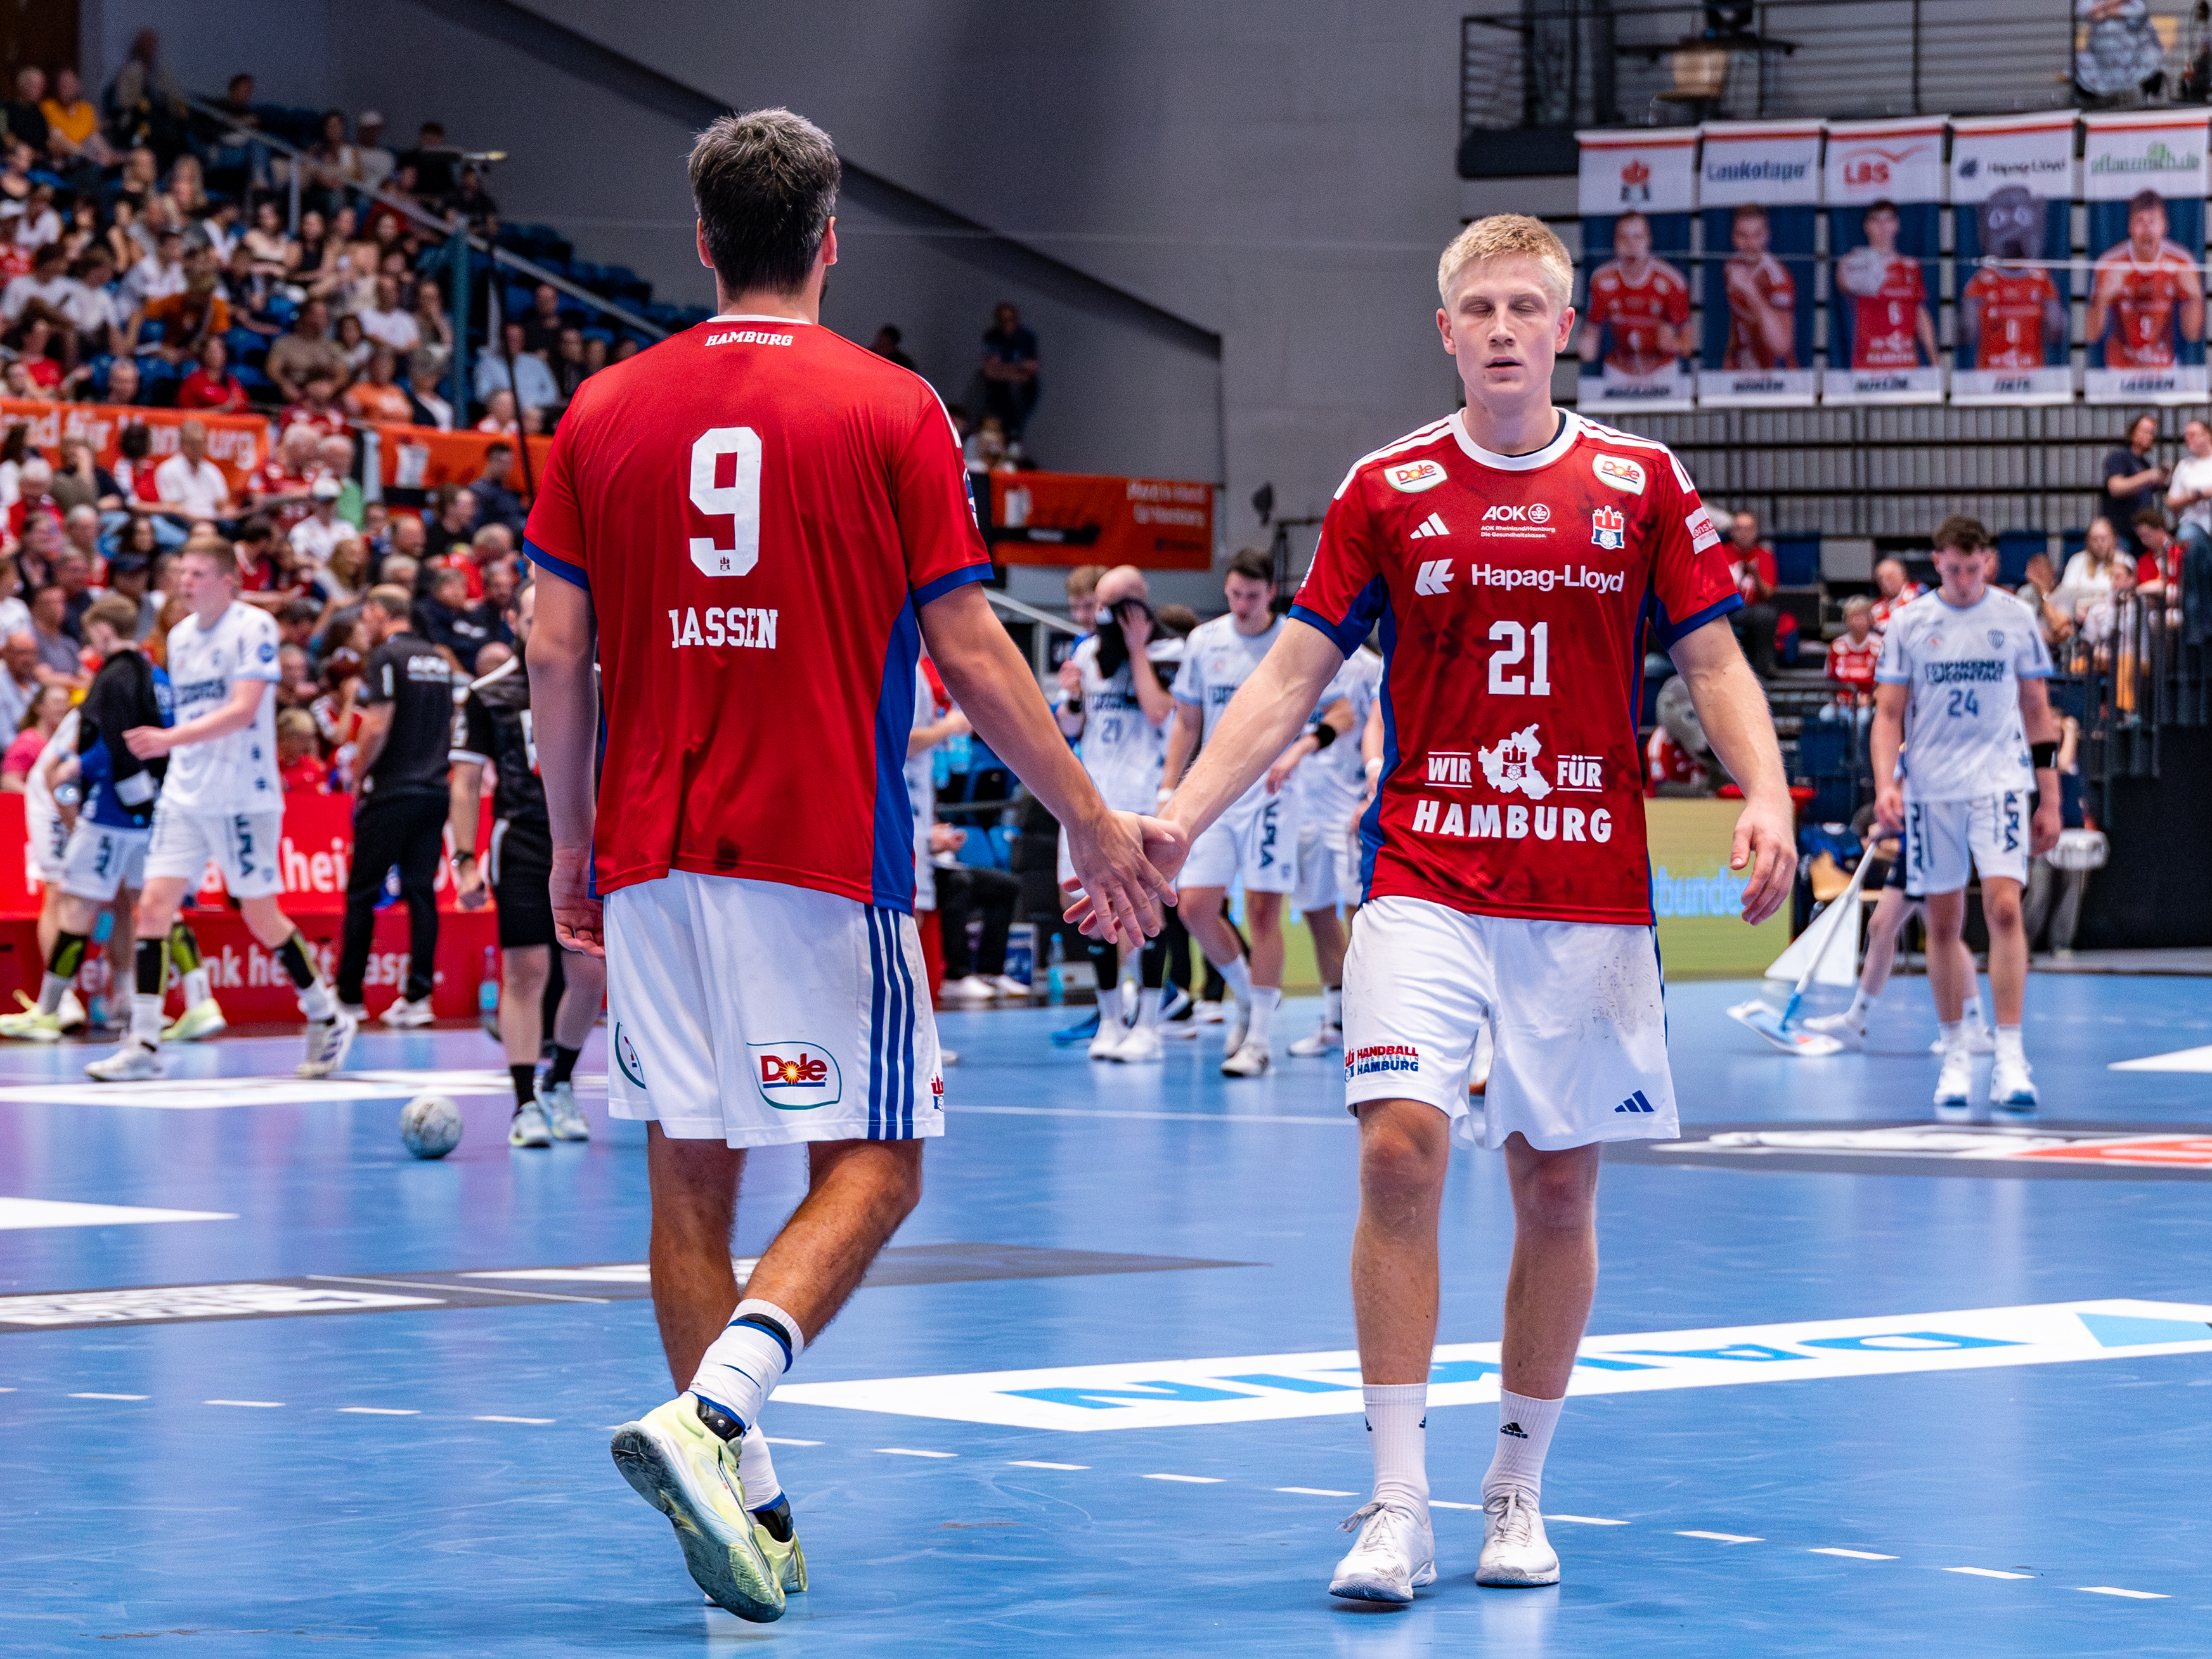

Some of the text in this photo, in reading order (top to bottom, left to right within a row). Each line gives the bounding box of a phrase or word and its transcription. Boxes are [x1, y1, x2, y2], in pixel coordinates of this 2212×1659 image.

[1844, 162, 1889, 184] LBS
[704, 331, 794, 346] HAMBURG
[1395, 465, 1435, 482] Dole
[1601, 460, 1640, 481] Dole
[689, 427, 763, 577] 9
[1481, 505, 1527, 521] AOK
[1471, 564, 1624, 593] Hapag-Lloyd
[1488, 620, 1551, 696] 21
[1947, 688, 1979, 717] 24
[1428, 754, 1602, 787] WIR FÜR
[1411, 800, 1612, 842] HAMBURG
[1652, 865, 1752, 917] bunde
[1357, 1046, 1419, 1059] HANDBALL
[760, 1053, 827, 1085] Dole
[1357, 1061, 1419, 1075] HAMBURG
